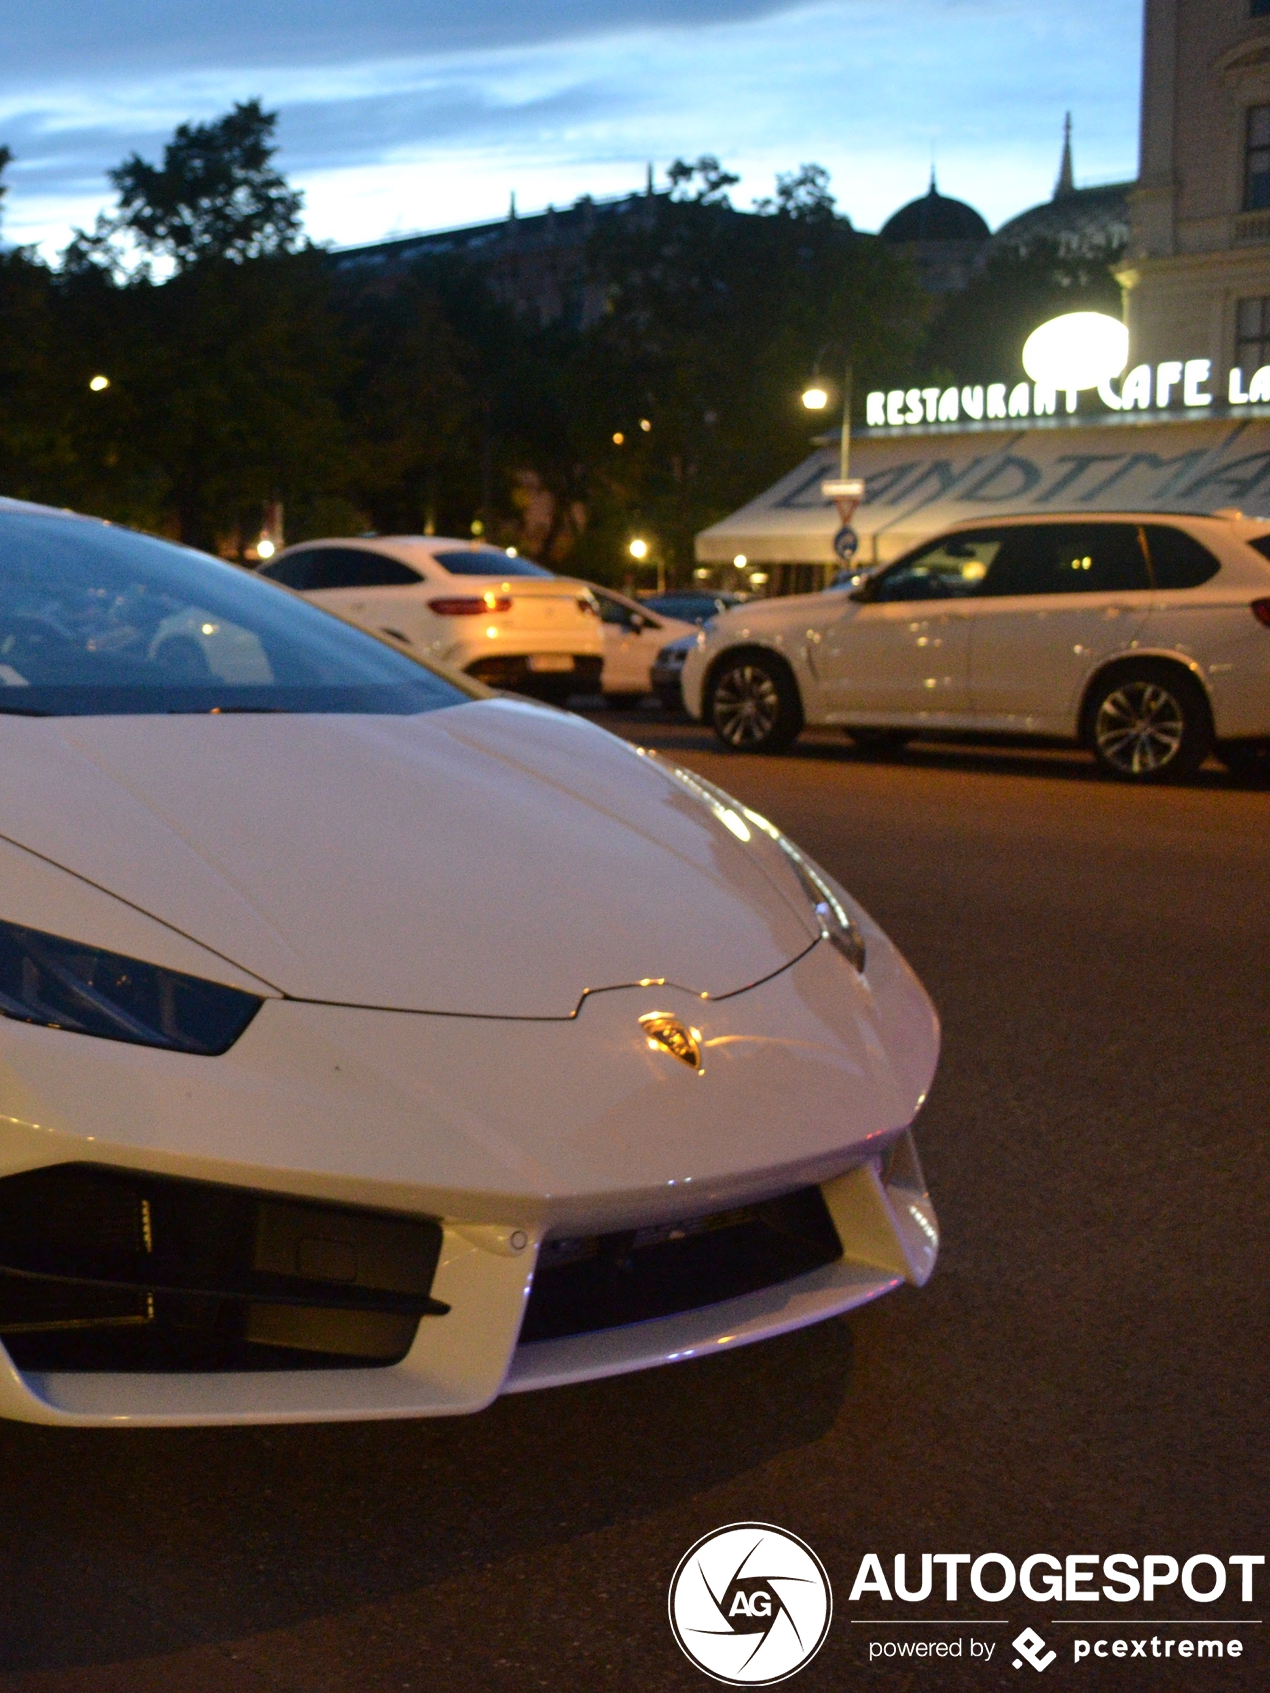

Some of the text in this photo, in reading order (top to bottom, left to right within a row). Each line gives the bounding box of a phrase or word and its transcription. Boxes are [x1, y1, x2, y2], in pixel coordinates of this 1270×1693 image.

[866, 382, 1077, 426] RESTAURANT
[1097, 358, 1212, 410] CAFE
[776, 446, 1270, 507] LANDTMA
